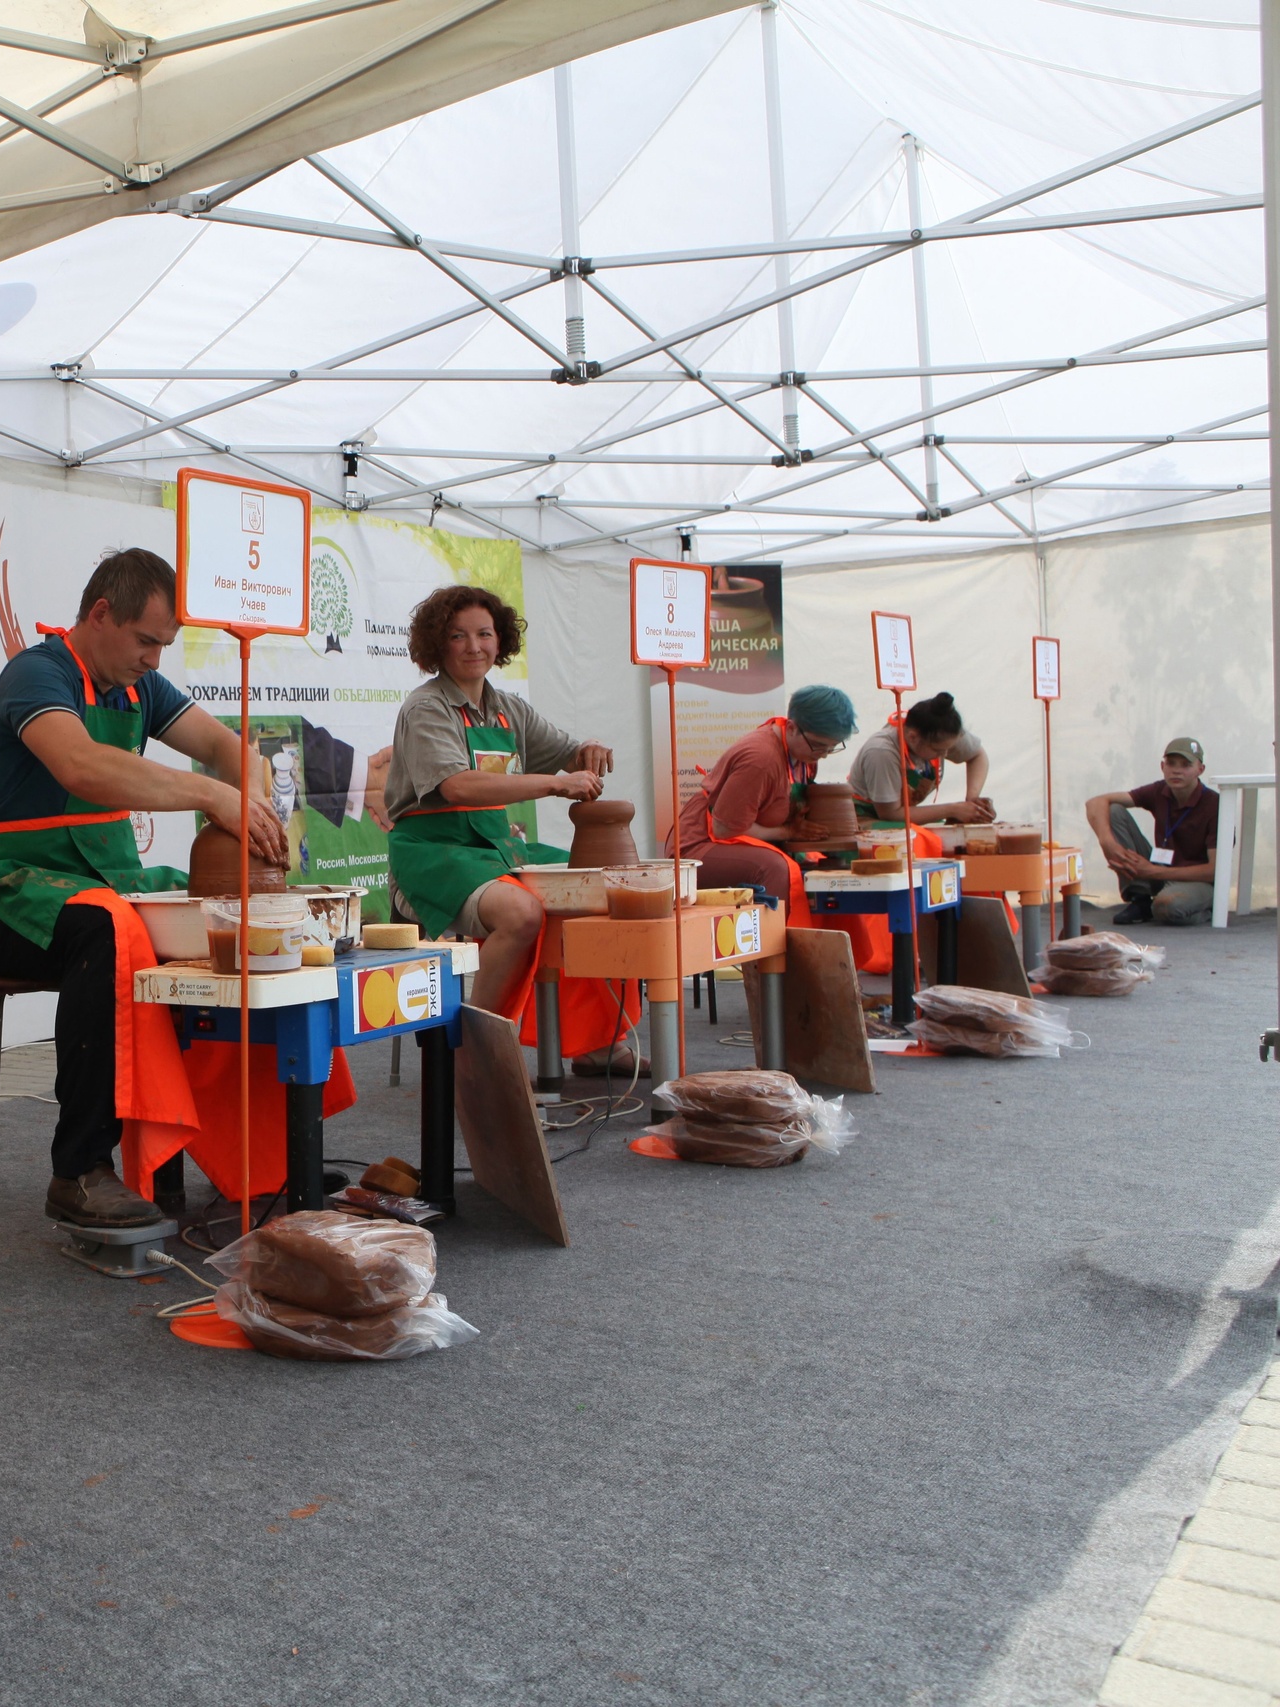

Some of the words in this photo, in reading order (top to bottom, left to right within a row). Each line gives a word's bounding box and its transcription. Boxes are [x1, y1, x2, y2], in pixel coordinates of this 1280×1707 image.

[248, 540, 261, 570] 5
[214, 575, 236, 589] Иван
[241, 578, 292, 597] Викторович
[241, 597, 266, 611] Учаев
[667, 603, 674, 623] 8
[364, 619, 396, 635] Палата
[710, 620, 741, 632] АША
[366, 645, 408, 659] промыслов
[711, 638, 778, 651] ИЧЕСКАЯ
[893, 643, 898, 658] 9
[691, 658, 749, 673] УДИЯ
[265, 686, 329, 702] ТРАДИЦИИ
[333, 687, 402, 703] ОБЪЕДИНЯЕМ
[316, 858, 347, 870] Россия,
[348, 853, 388, 866] Московска
